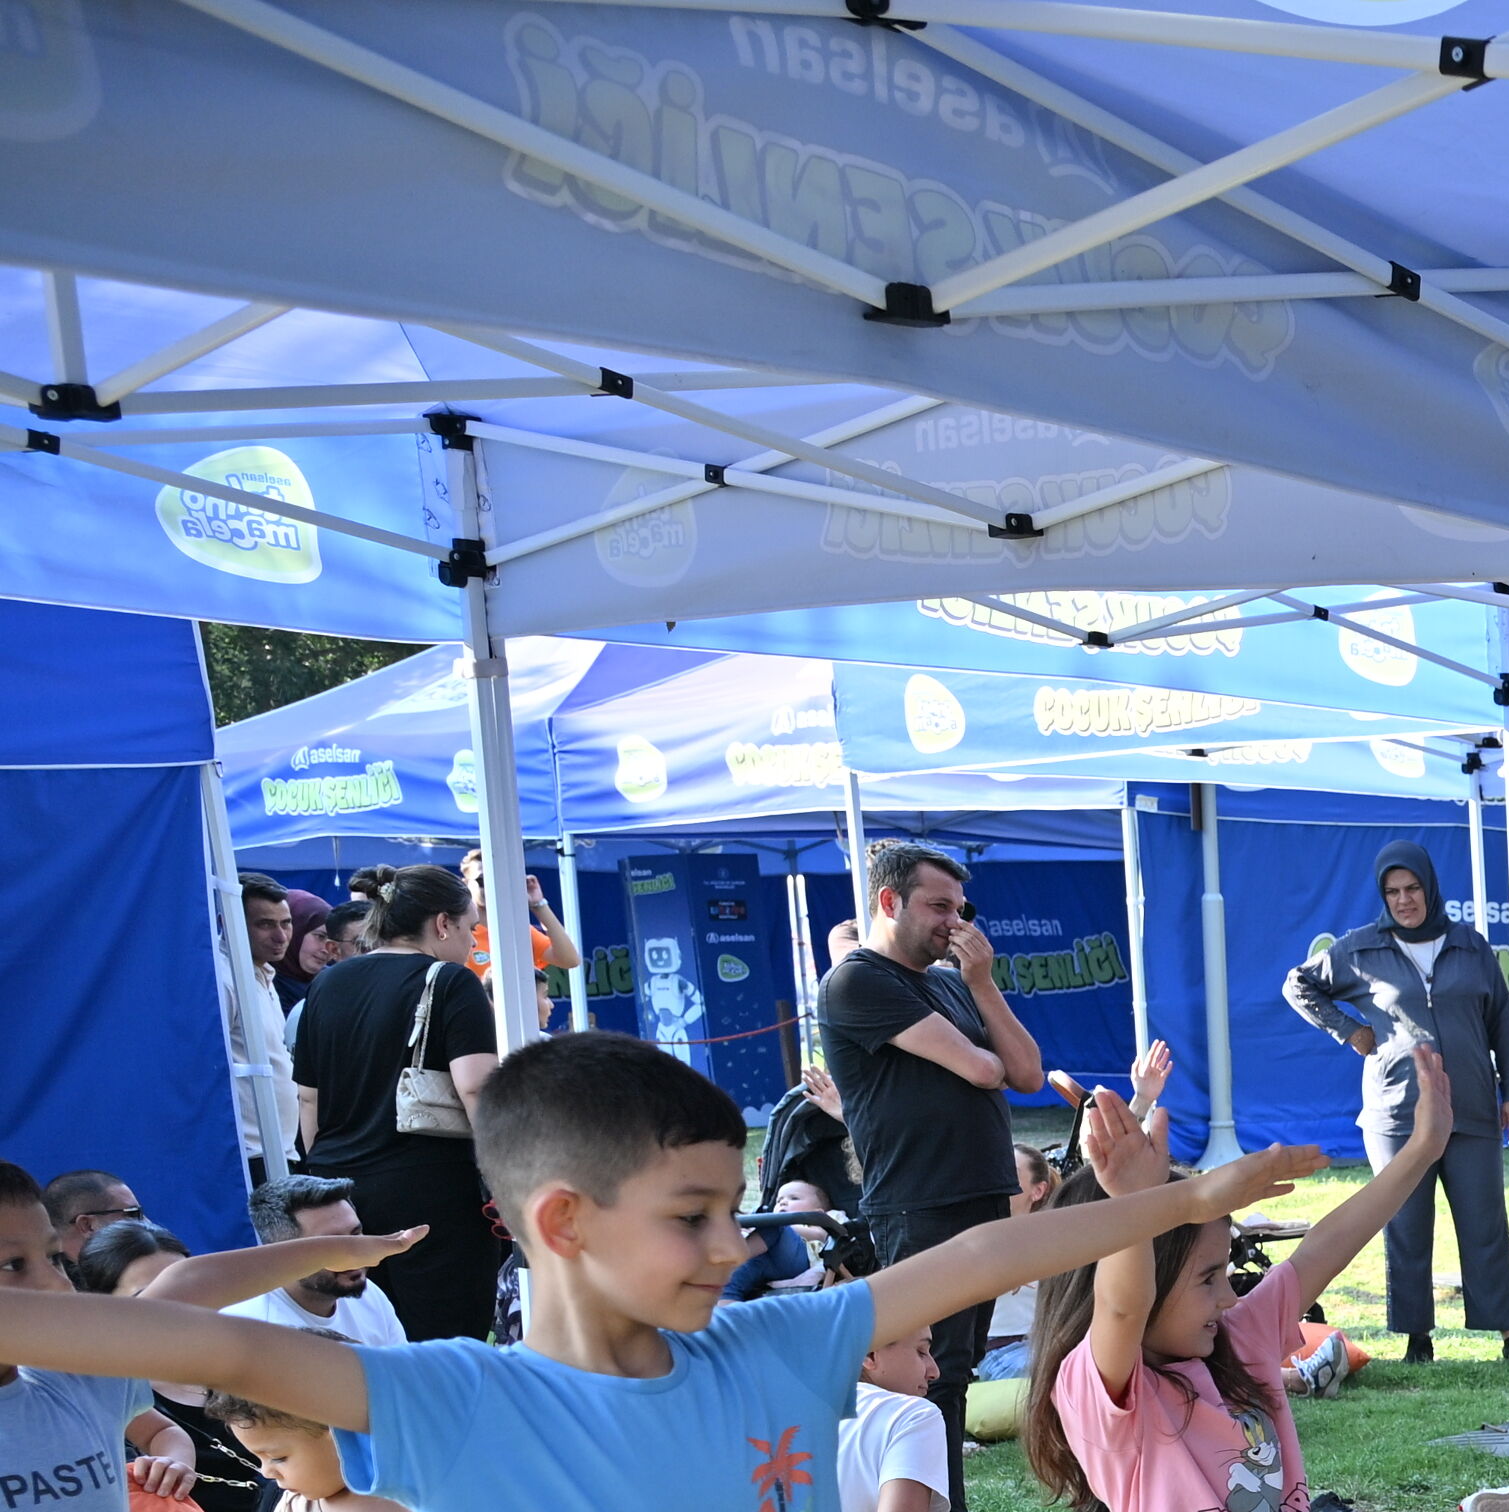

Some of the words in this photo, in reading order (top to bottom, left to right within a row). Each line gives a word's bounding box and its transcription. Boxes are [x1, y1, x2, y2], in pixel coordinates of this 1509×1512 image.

[1034, 686, 1133, 736] ÇOCUK
[309, 744, 361, 763] aselsan
[262, 777, 323, 816] ÇOCUK
[988, 914, 1063, 936] aselsan
[1013, 932, 1130, 998] ŞENLİĞİ
